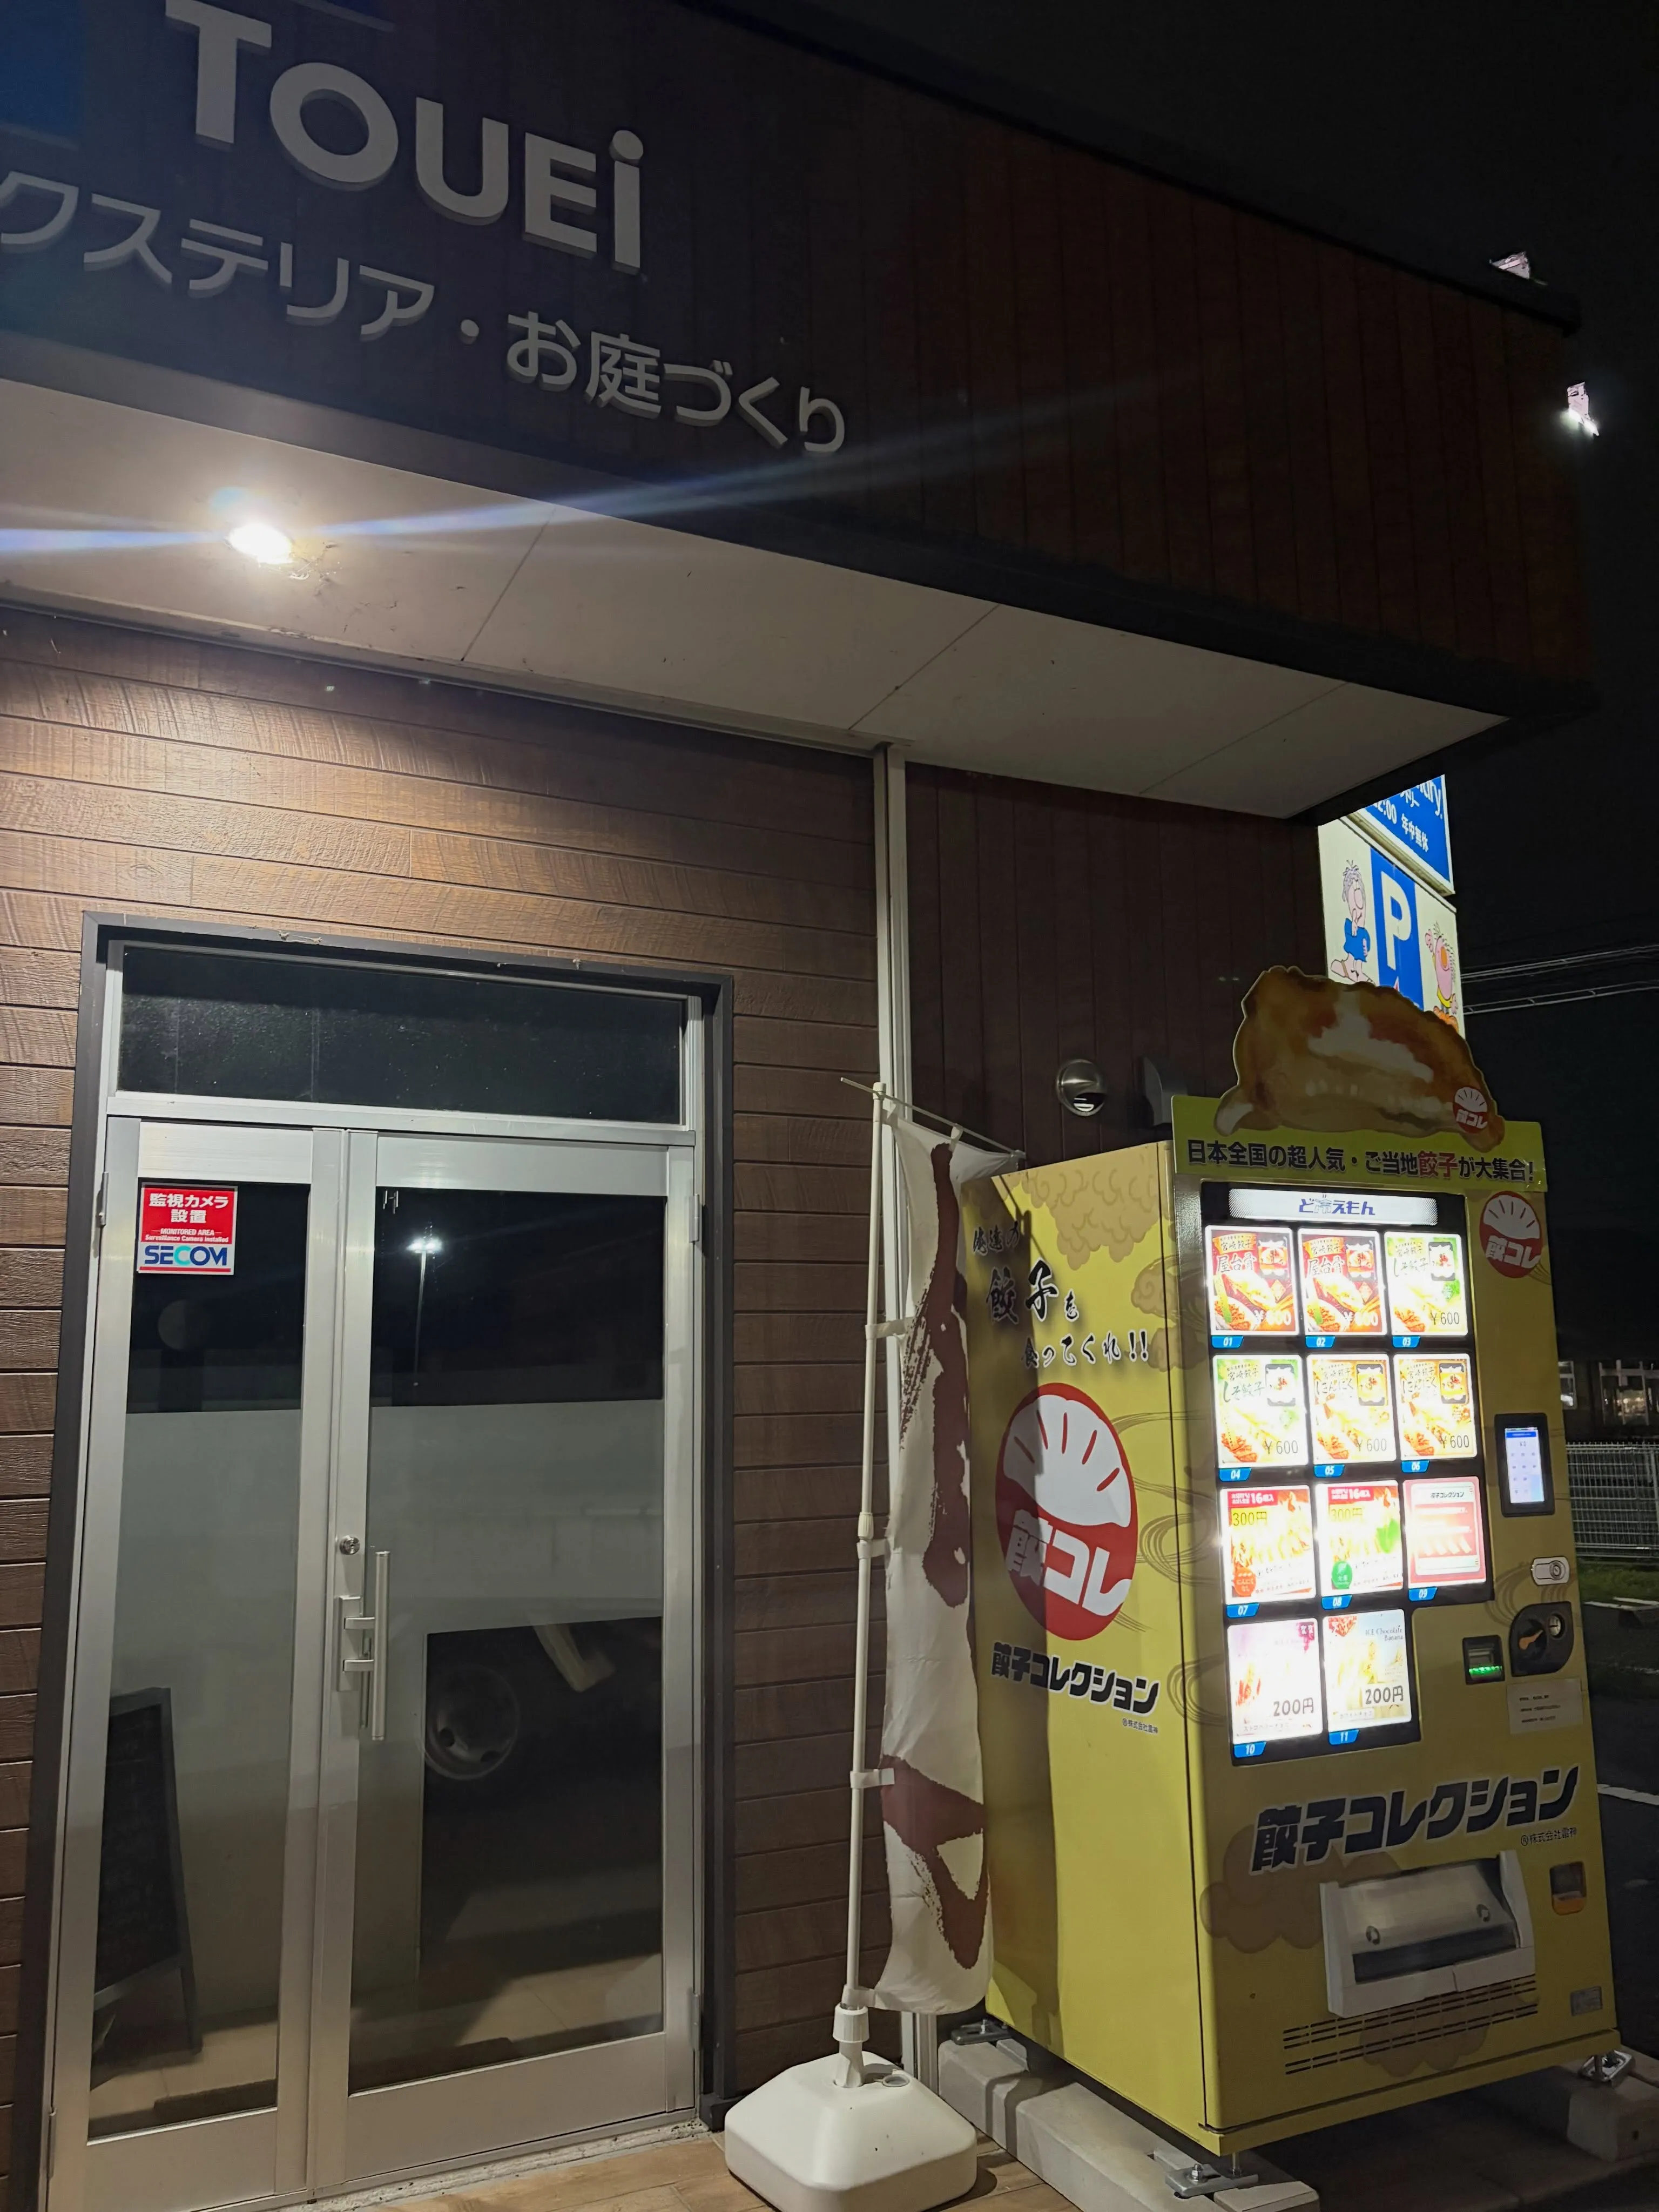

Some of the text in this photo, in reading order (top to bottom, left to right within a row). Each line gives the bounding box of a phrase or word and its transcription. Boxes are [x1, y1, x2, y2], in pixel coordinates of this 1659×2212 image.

[1401, 813, 1429, 852] 年中無休
[1381, 871, 1412, 970] P
[149, 1193, 229, 1209] 監視カメラ
[171, 1209, 207, 1223] 設置
[144, 1245, 228, 1266] SECOM
[986, 1258, 1080, 1325] 餃子を
[1223, 1337, 1233, 1347] 01
[1316, 1337, 1326, 1347] 02
[1230, 1469, 1241, 1480] 04
[1232, 1511, 1267, 1527] 300円
[1237, 1605, 1248, 1615] 07
[991, 1641, 1159, 1714] 餃子コレクション
[1365, 1685, 1404, 1705] 200円
[1273, 1697, 1315, 1717] 200円
[1340, 1731, 1349, 1742] 11
[1245, 1744, 1256, 1755] 10
[1251, 1765, 1579, 1872] 餃子コレクション
